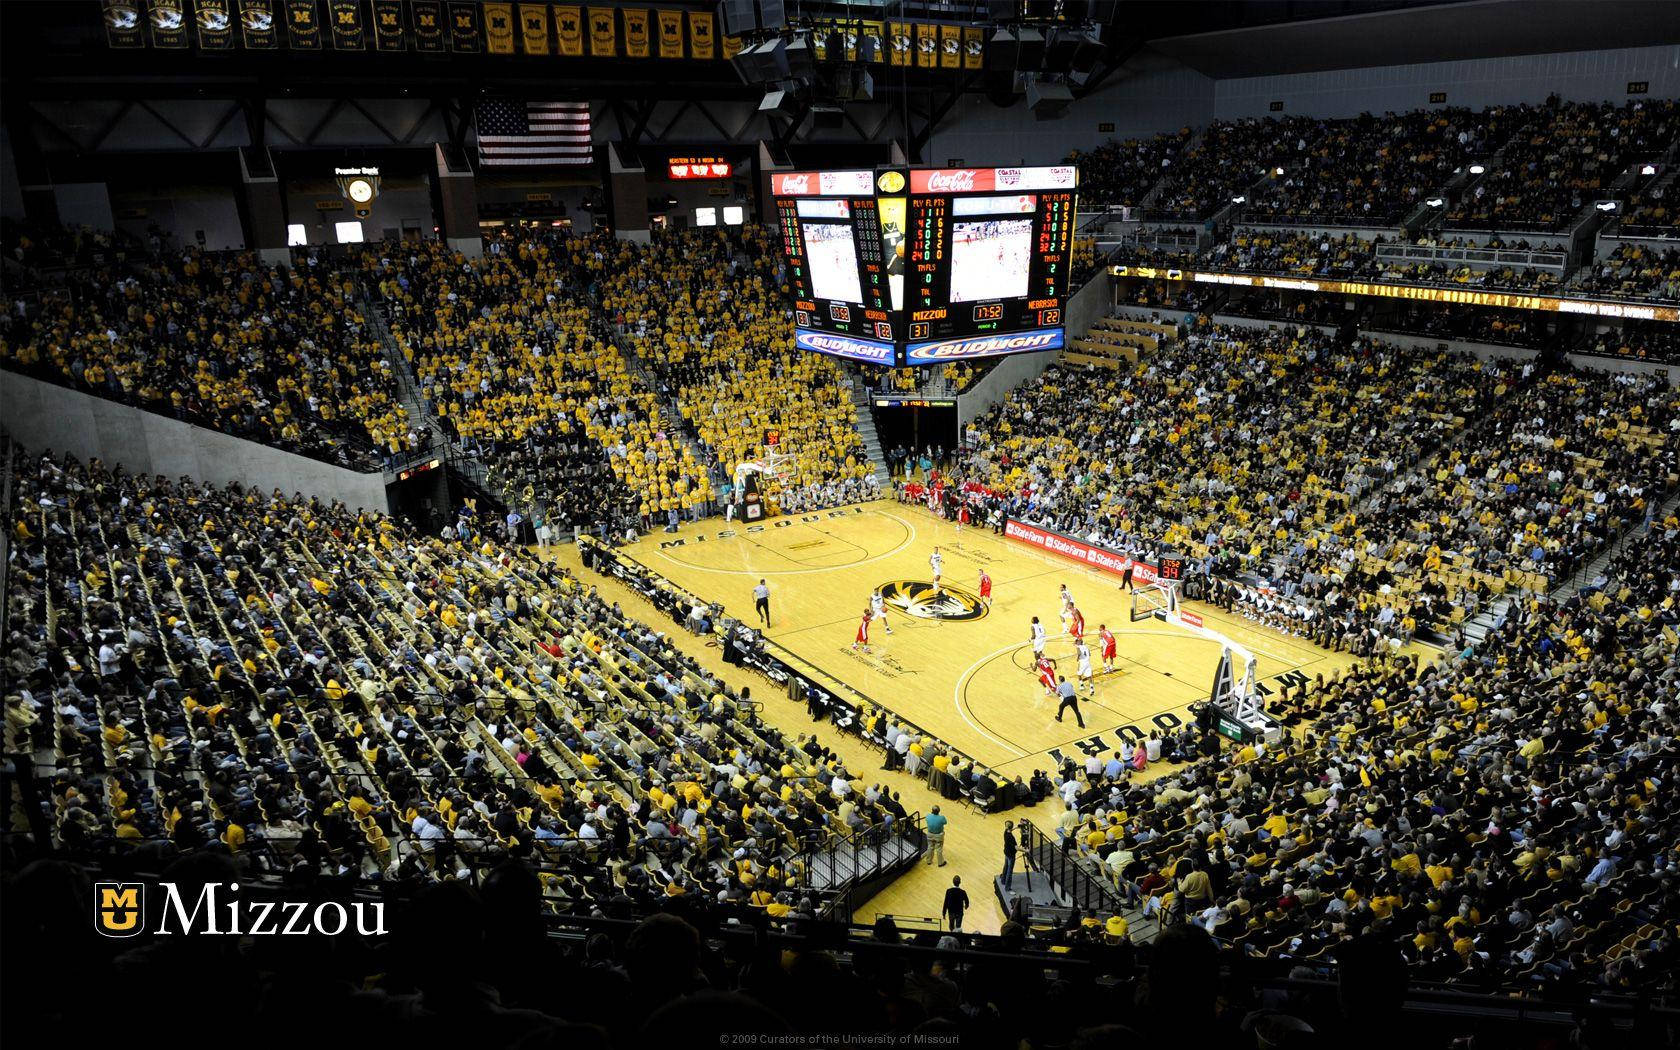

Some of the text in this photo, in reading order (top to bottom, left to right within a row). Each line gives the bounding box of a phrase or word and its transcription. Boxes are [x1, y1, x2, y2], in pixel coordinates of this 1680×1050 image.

[293, 10, 311, 24] M
[338, 11, 355, 25] M
[381, 13, 397, 26] M
[1341, 282, 1369, 295] TIGER
[1374, 285, 1399, 297] TALK
[1404, 288, 1438, 300] EVERY
[912, 309, 947, 321] MIZZOU
[1046, 312, 1059, 322] 22
[1162, 567, 1179, 580] 34
